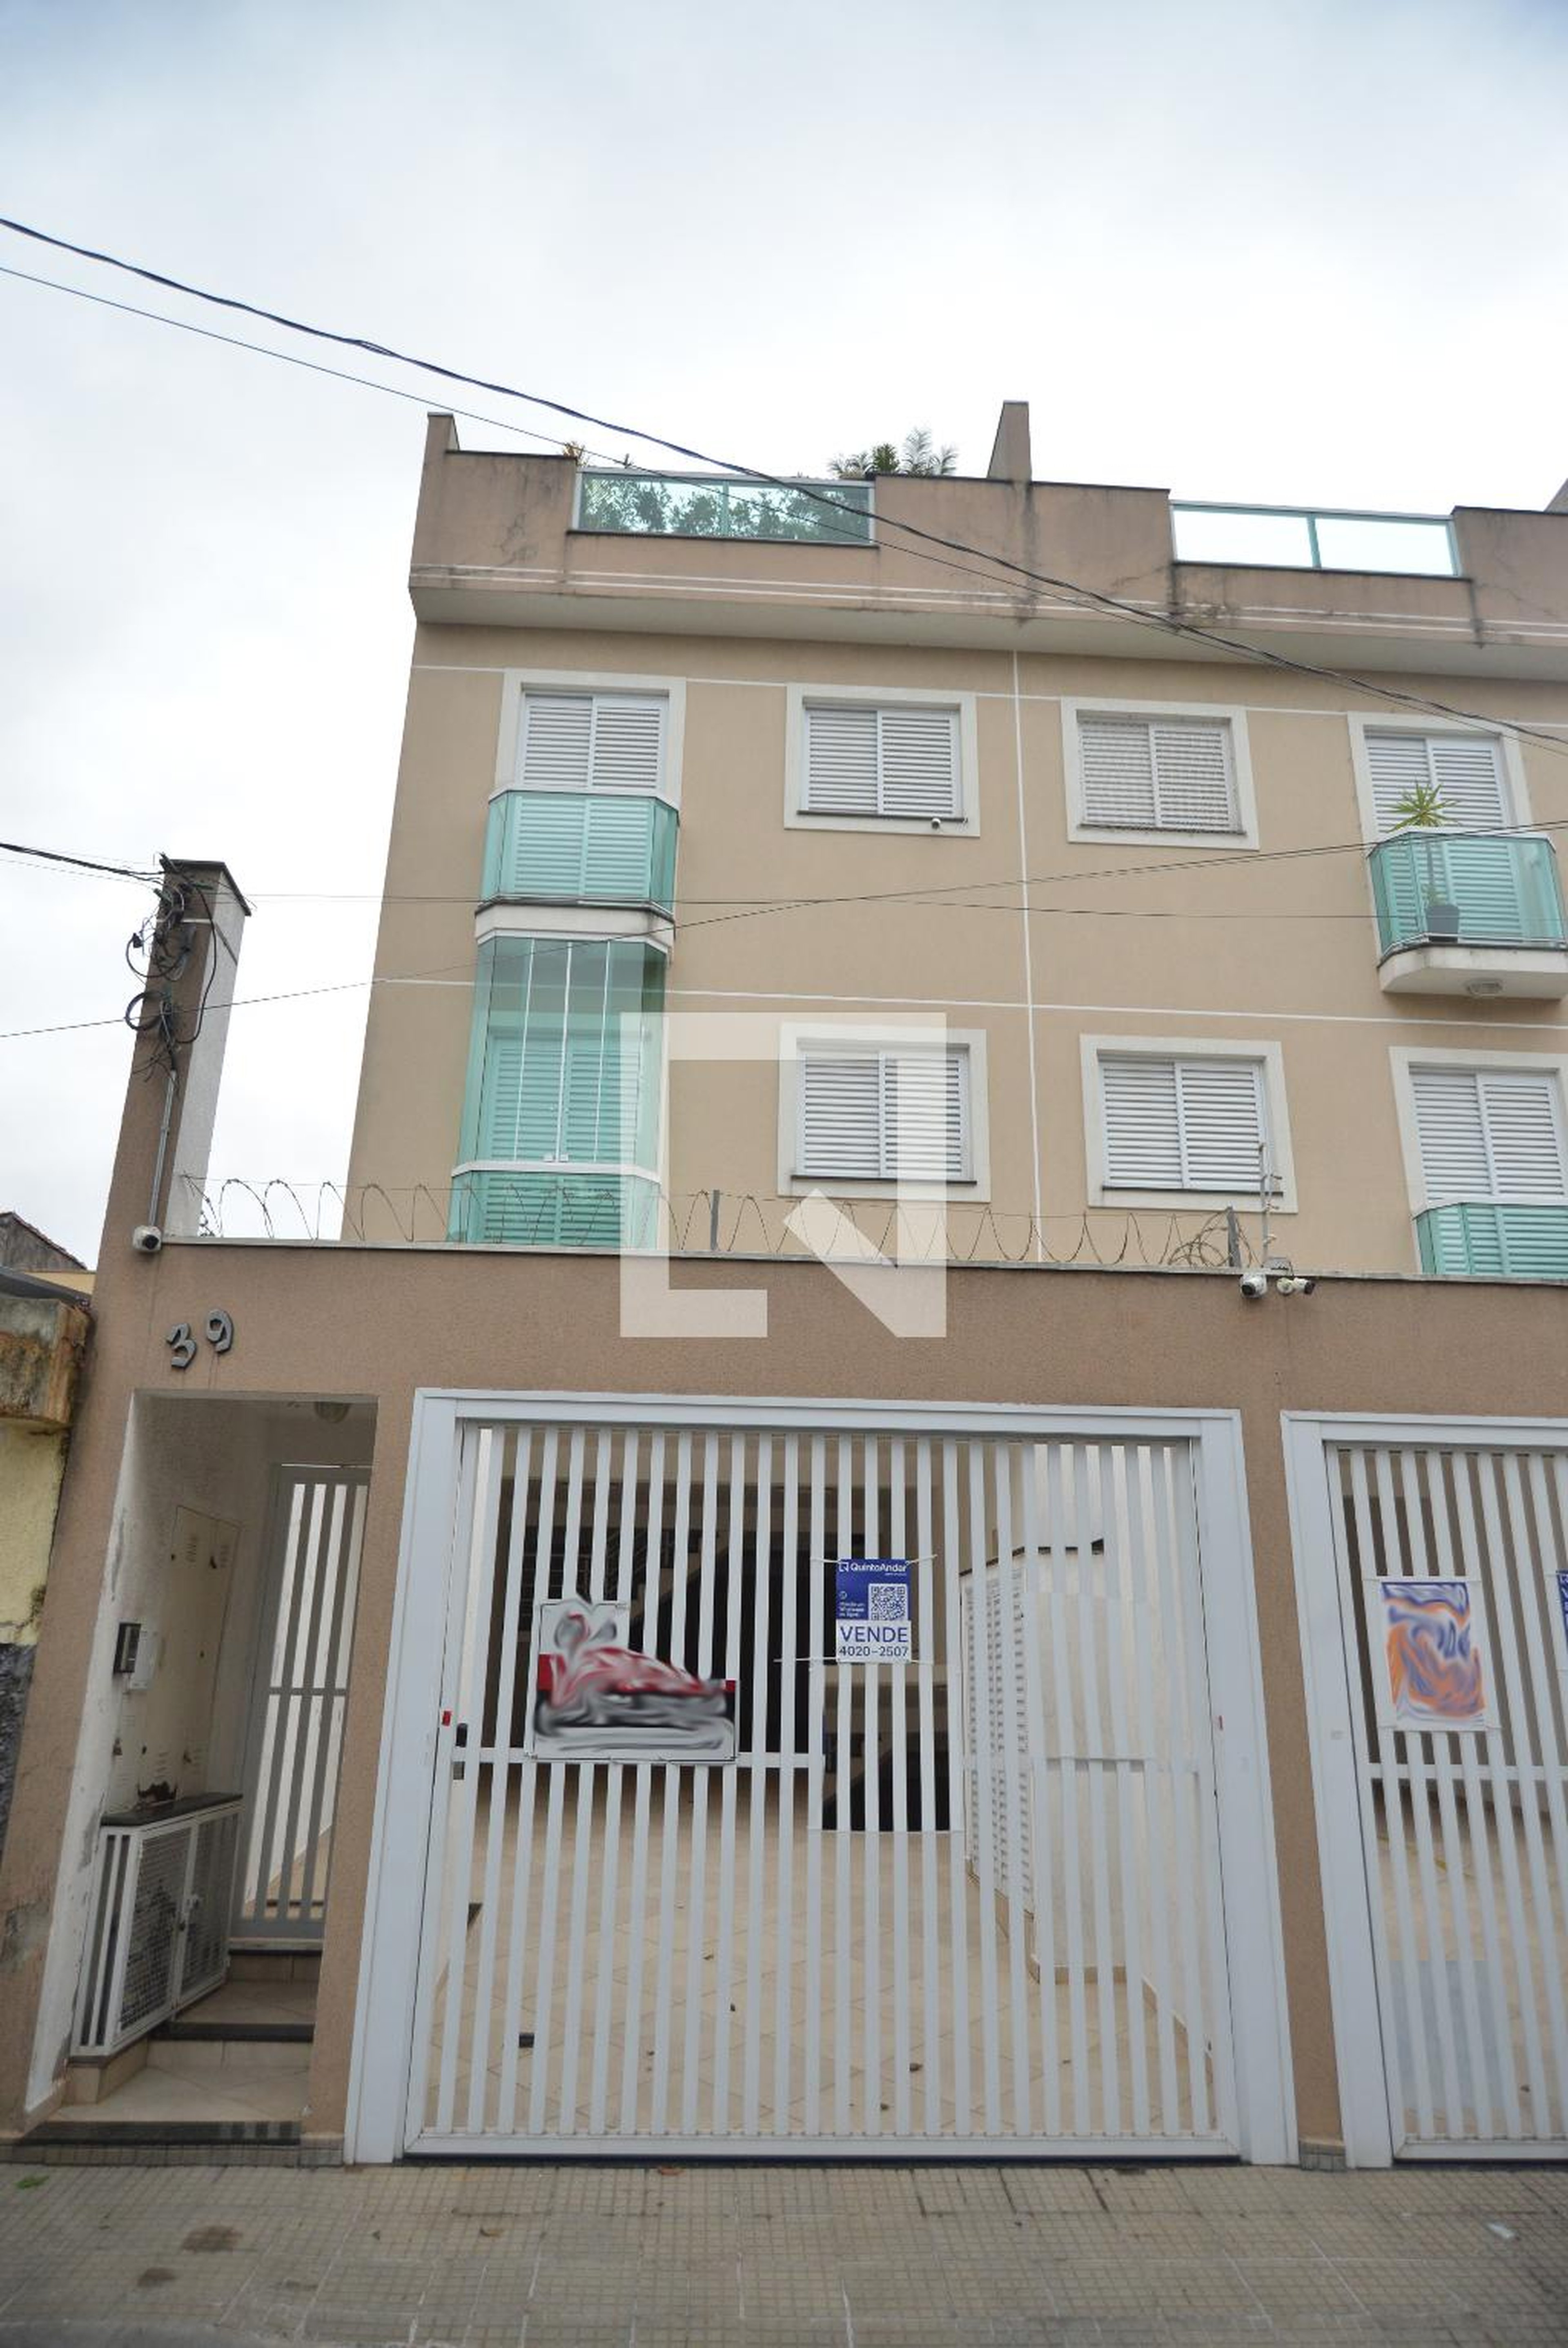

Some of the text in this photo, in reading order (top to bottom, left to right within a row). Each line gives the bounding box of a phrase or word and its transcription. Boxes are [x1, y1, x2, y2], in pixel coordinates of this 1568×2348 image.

[166, 1309, 233, 1368] 39
[850, 1562, 906, 1572] QuintoAndar
[840, 1626, 908, 1643] VENDE
[839, 1646, 909, 1657] 4020-2507
